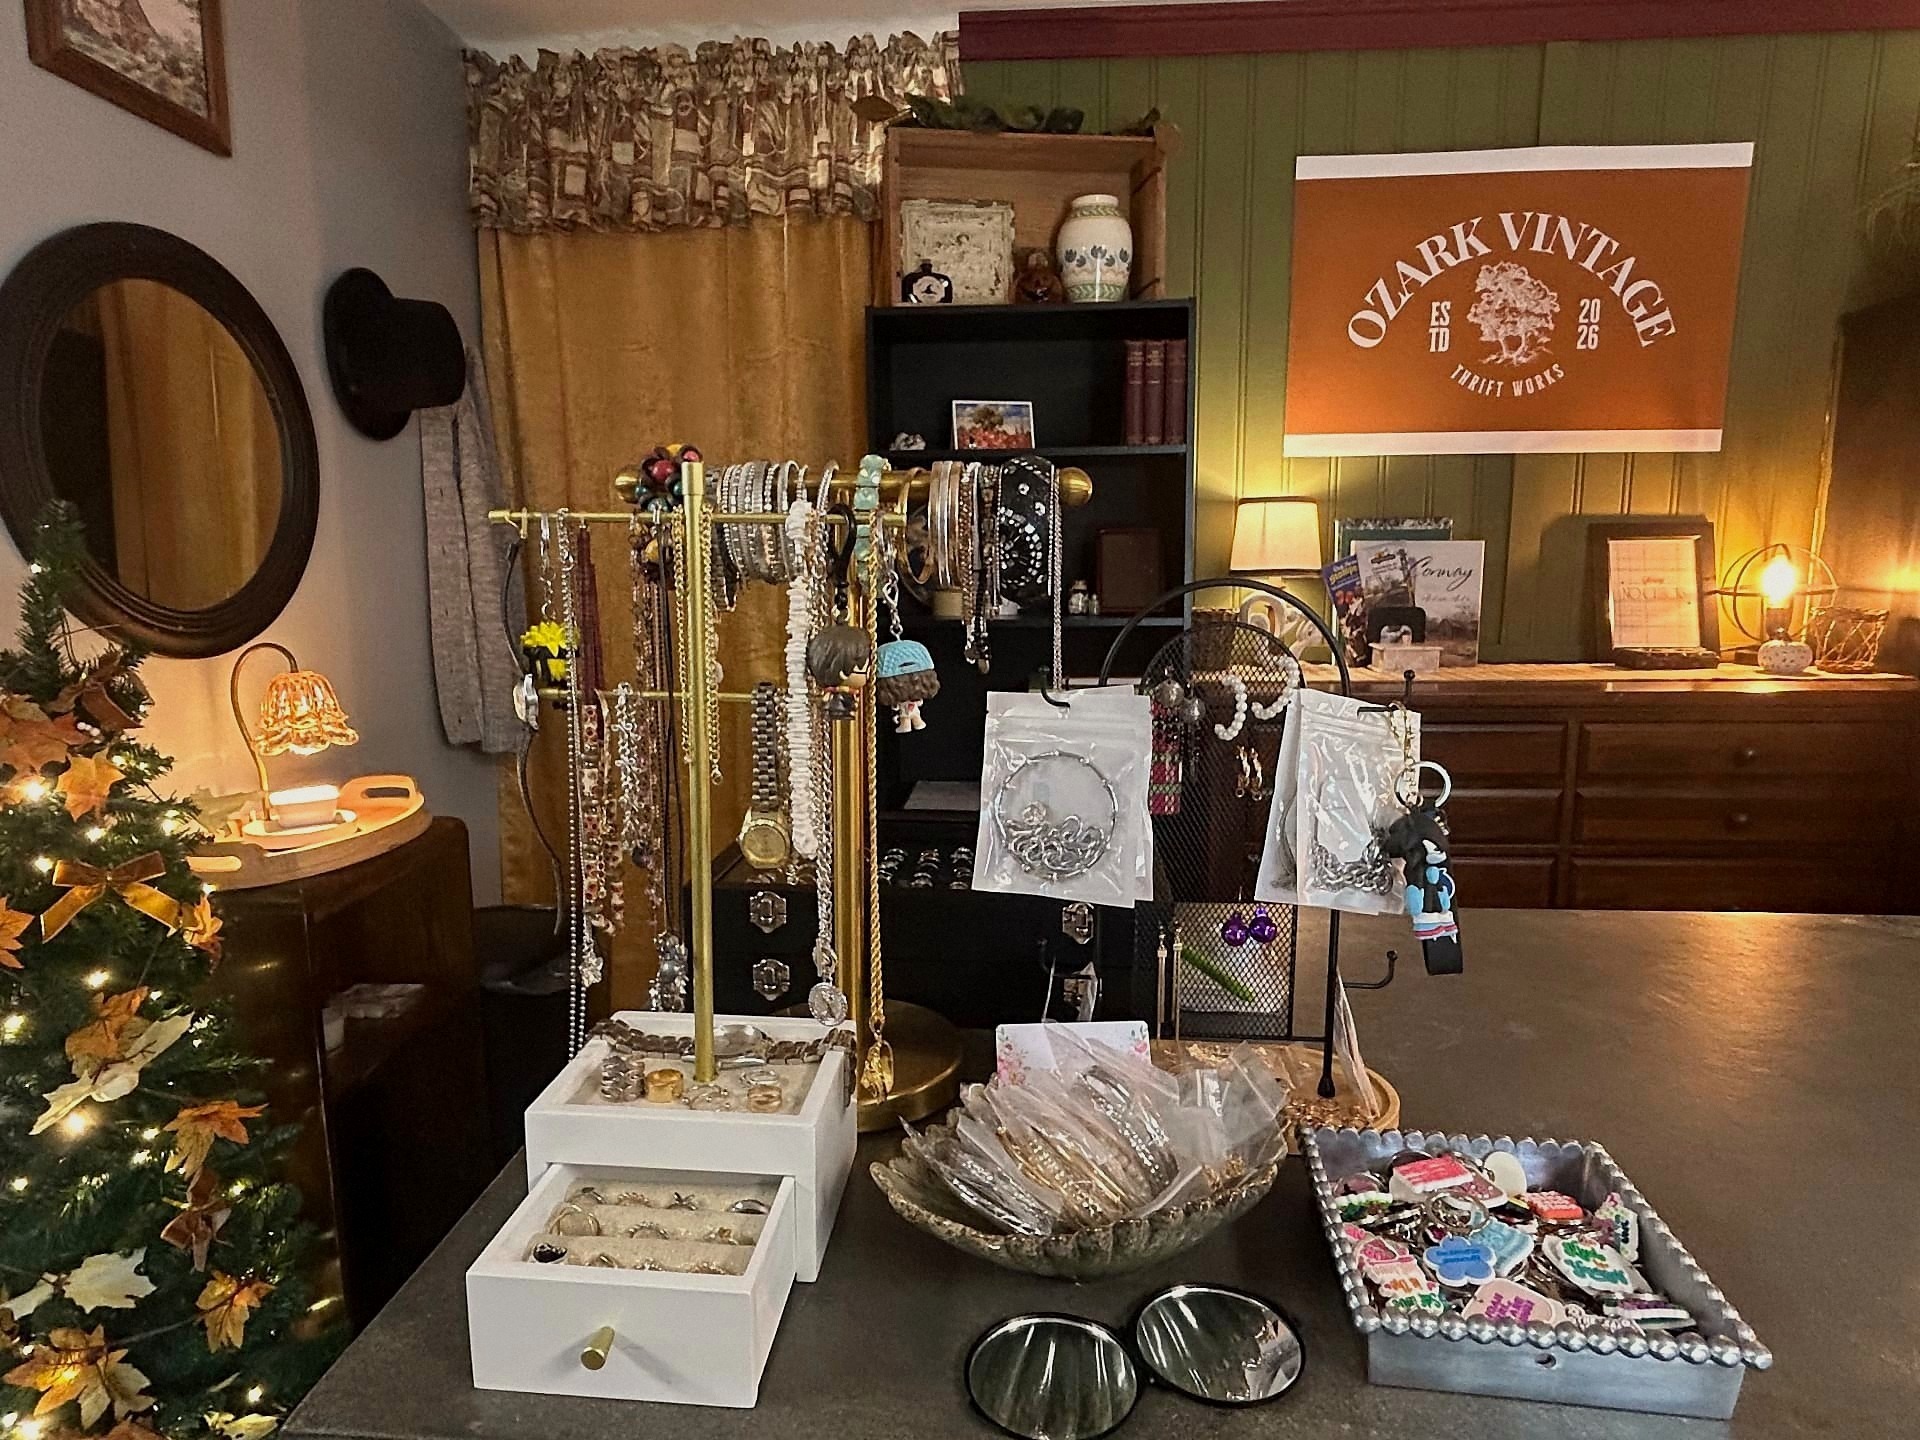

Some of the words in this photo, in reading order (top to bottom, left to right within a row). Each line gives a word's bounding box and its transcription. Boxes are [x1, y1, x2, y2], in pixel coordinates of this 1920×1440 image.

[1348, 216, 1492, 348] OZARK
[1499, 211, 1676, 348] VINTAGE
[1430, 301, 1451, 327] ES
[1579, 298, 1600, 323] 20
[1429, 328, 1450, 352] TD
[1577, 325, 1599, 350] 26
[1450, 363, 1503, 398] THRIFT
[1513, 363, 1566, 397] WORKS
